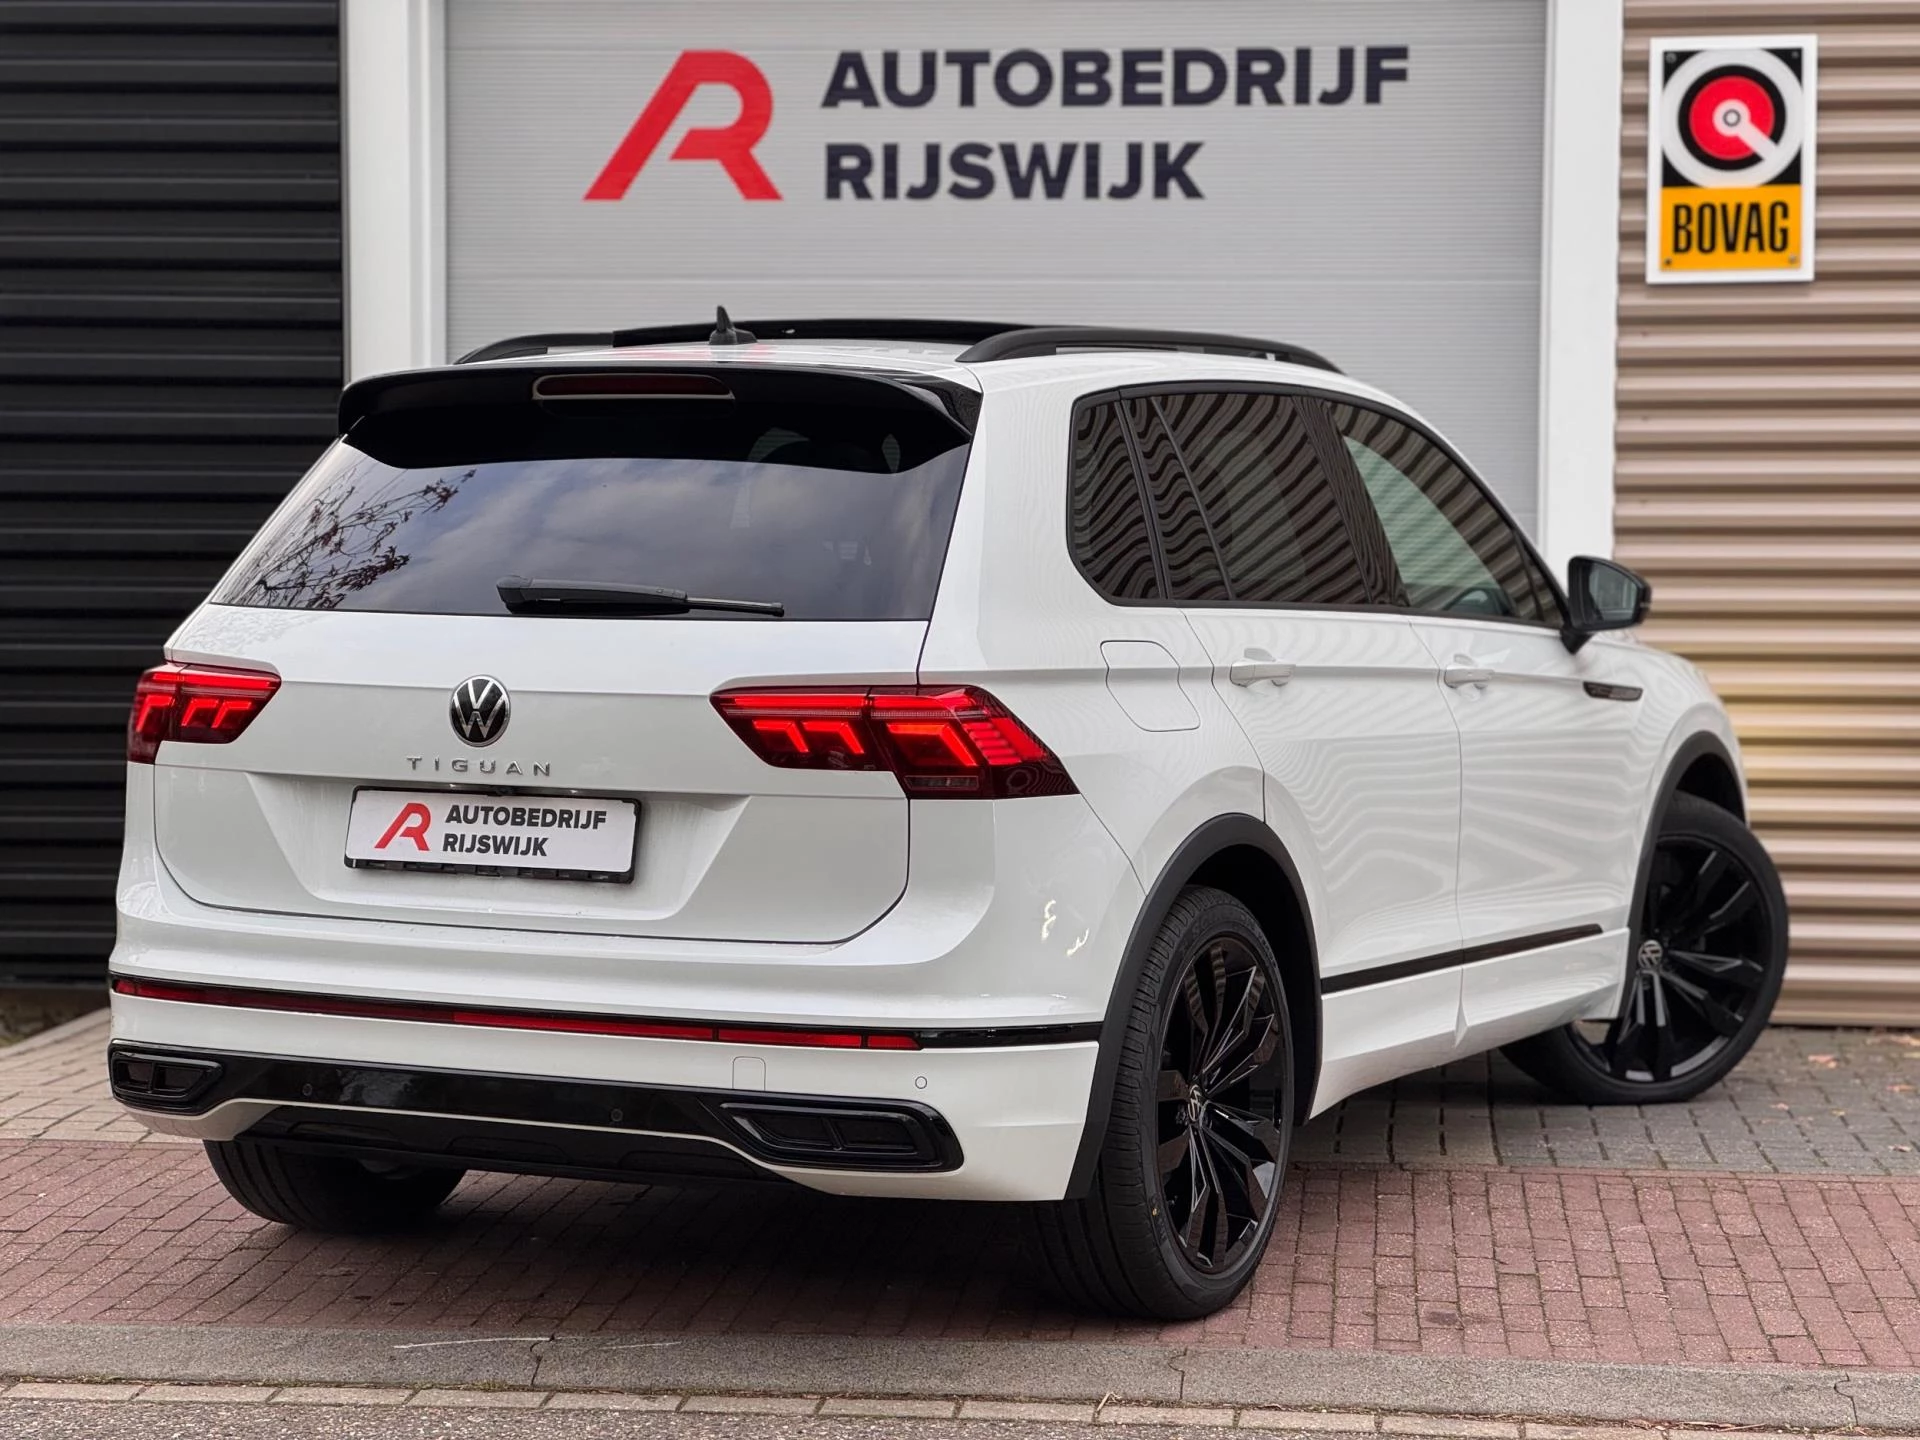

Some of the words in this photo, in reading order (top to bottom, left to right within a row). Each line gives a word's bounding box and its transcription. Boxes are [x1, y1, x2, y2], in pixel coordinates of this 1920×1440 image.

[820, 45, 1411, 109] AUTOBEDRIJF
[824, 141, 1206, 201] RIJSWIJK
[1672, 200, 1790, 255] BOVAG
[405, 755, 552, 777] TIGUAN
[444, 804, 607, 831] AUTOBEDRIJF
[442, 832, 549, 857] RIJSWIJK
